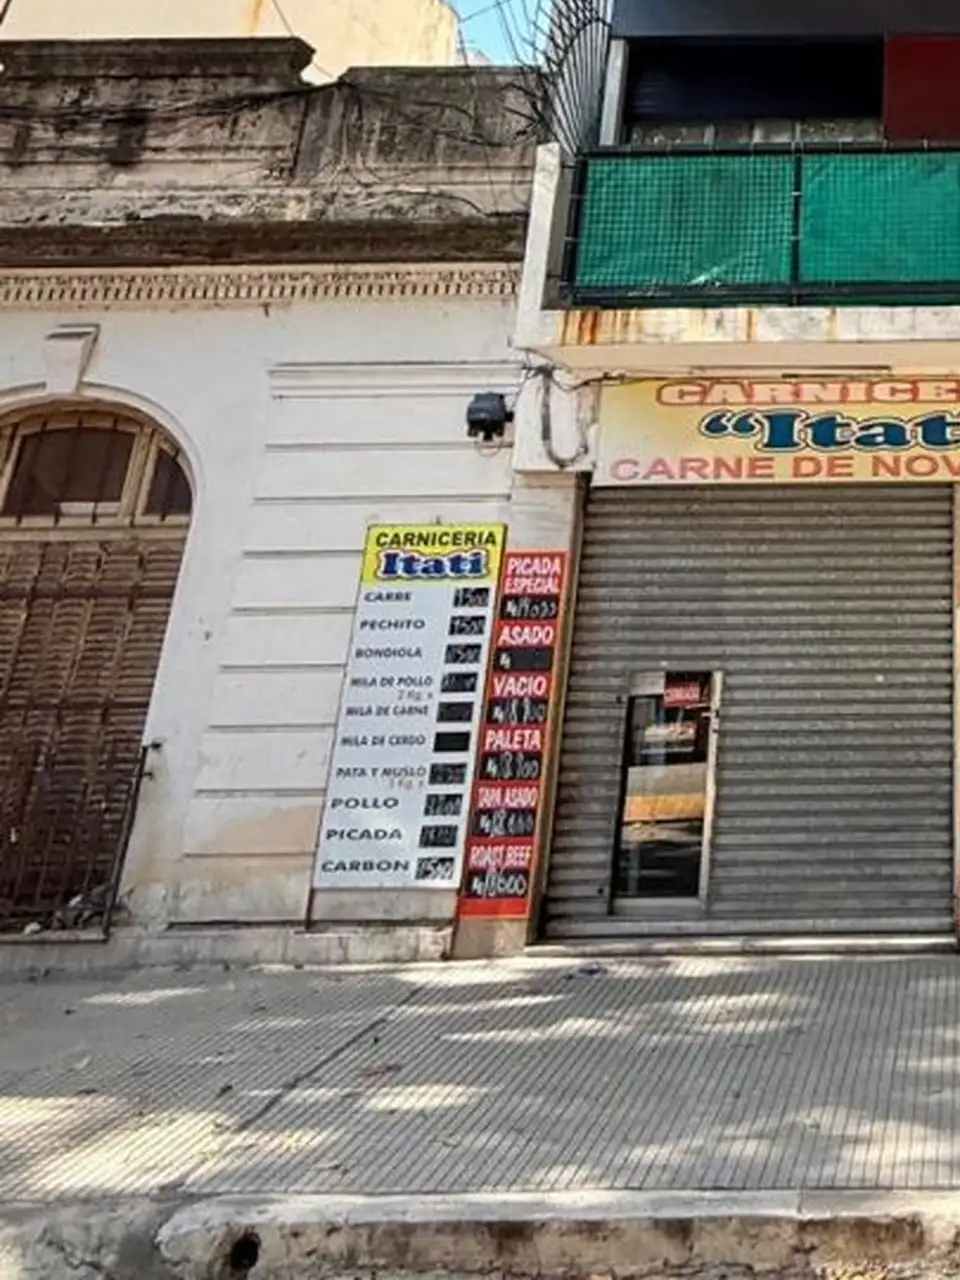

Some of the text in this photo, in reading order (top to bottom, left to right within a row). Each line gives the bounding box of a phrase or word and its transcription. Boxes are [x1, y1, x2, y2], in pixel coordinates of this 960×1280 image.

[610, 456, 775, 481] CARNE
[791, 455, 854, 480] DE
[375, 531, 497, 548] CARNICERIA
[379, 549, 487, 577] Itati
[507, 556, 562, 576] PICADA
[504, 577, 561, 595] ESPECIAL
[363, 591, 412, 603] CARRE
[359, 619, 426, 631] PECHITO
[499, 625, 555, 645] ASADO
[355, 647, 423, 659] BONDIOLA
[397, 675, 433, 687] POLLO
[493, 676, 548, 697] VACIO
[484, 729, 542, 752] PALETA
[336, 767, 367, 778] PATA
[331, 797, 399, 810] POLLO
[504, 786, 538, 807] ASADO
[326, 828, 403, 841] PICADA
[505, 845, 532, 866] BEEF
[321, 859, 410, 873] CARBON
